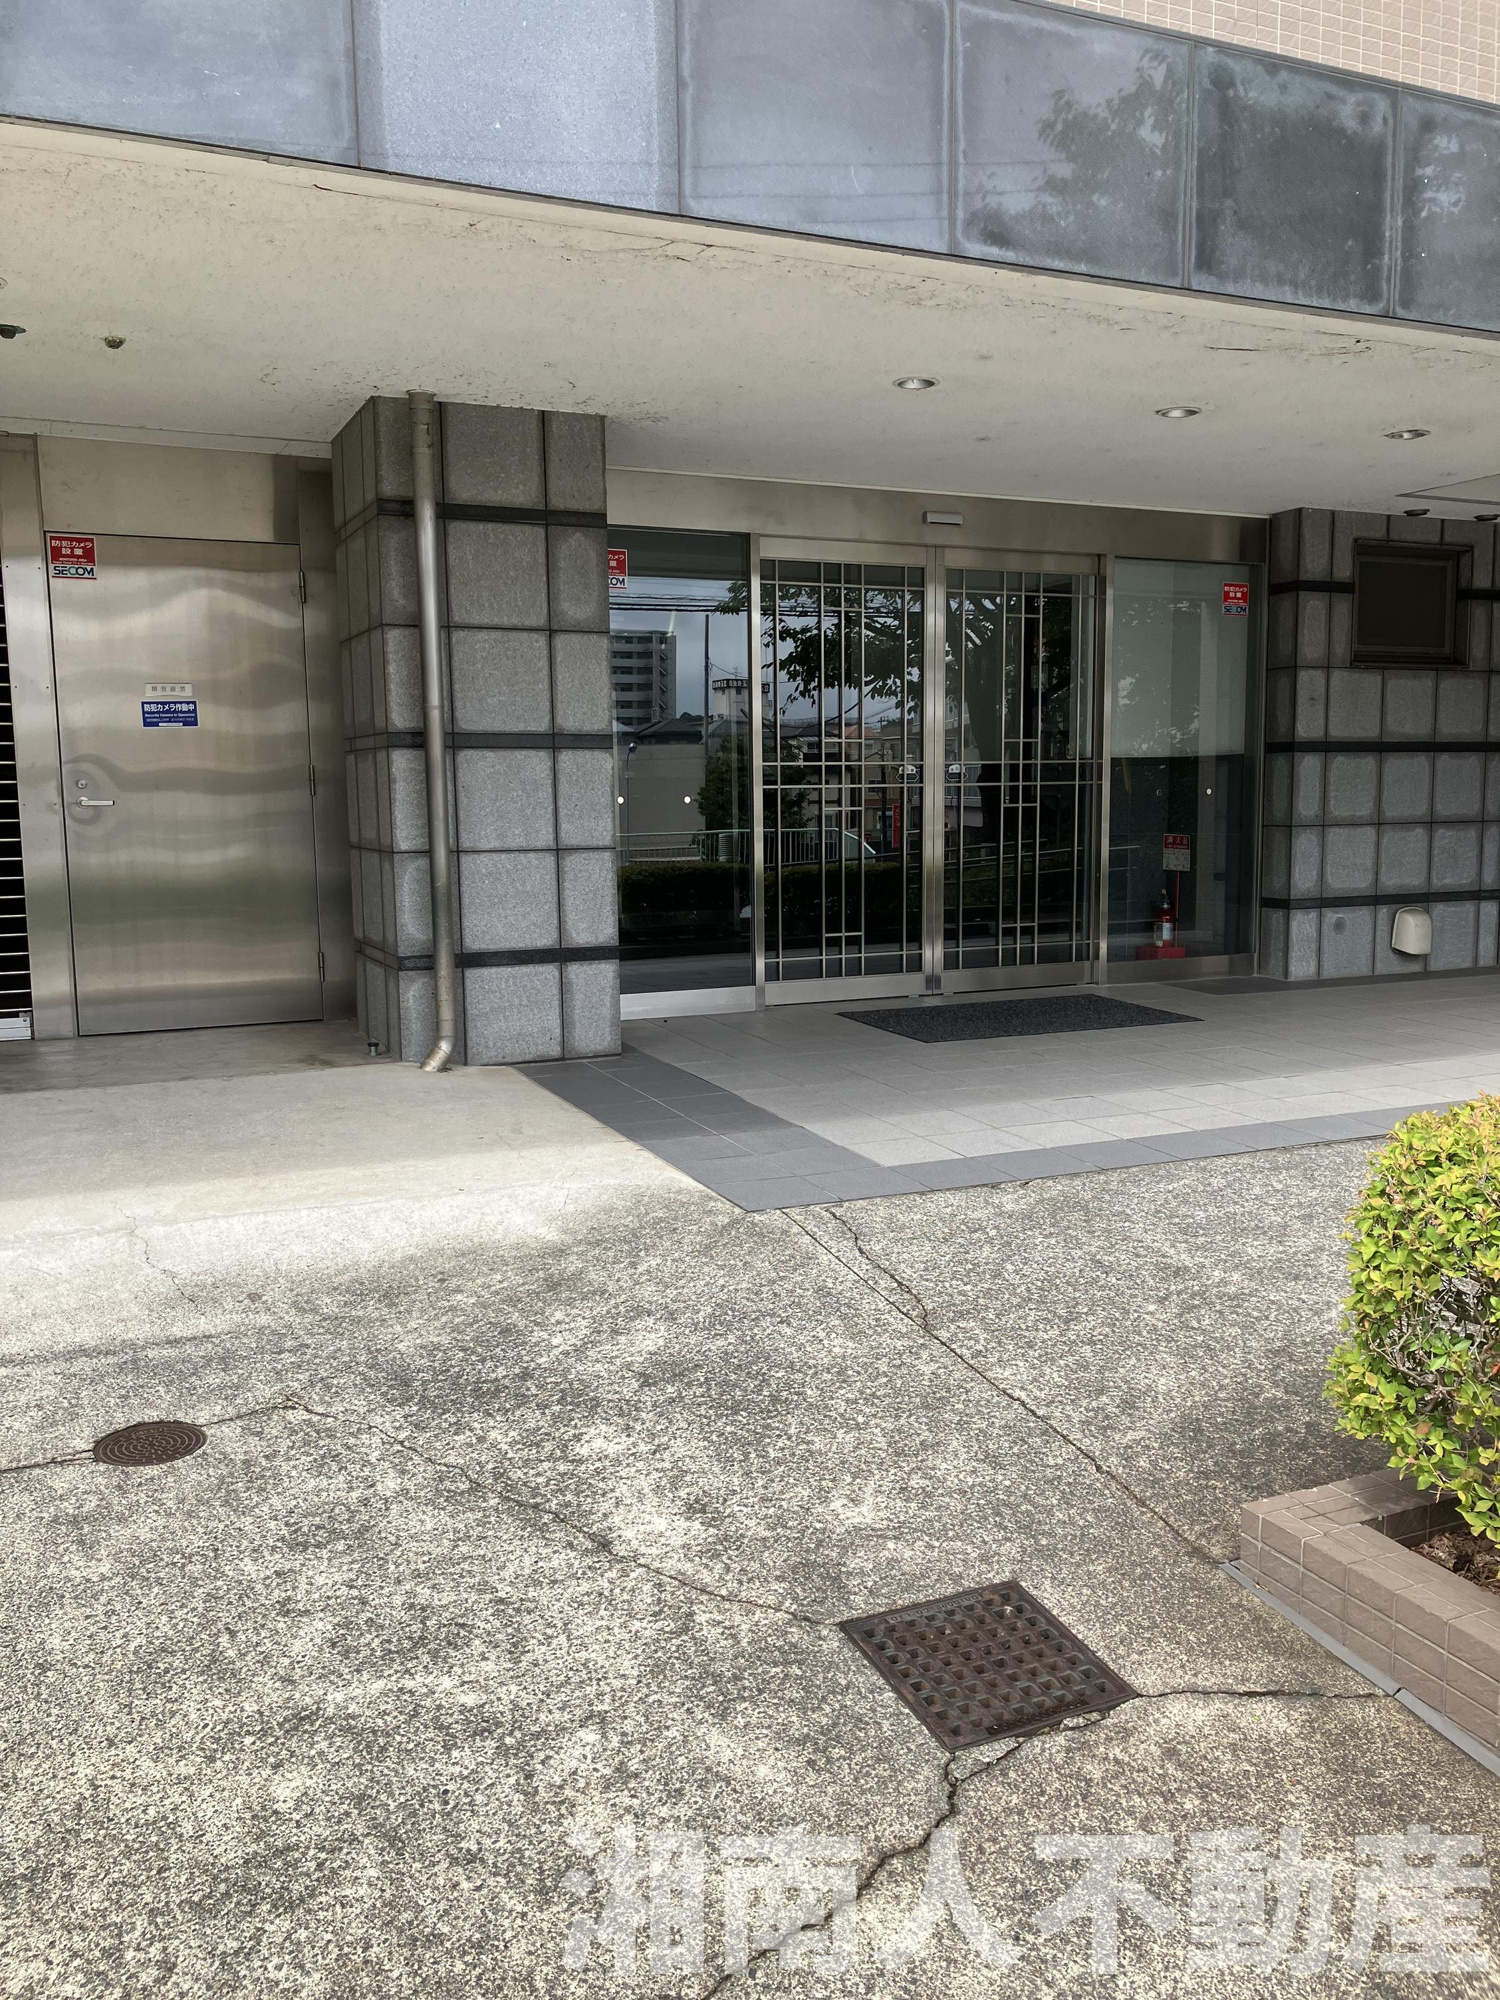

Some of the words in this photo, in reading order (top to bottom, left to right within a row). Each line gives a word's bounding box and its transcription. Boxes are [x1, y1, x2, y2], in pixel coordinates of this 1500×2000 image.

[51, 540, 93, 548] 防犯カメラ
[61, 548, 84, 556] 設置
[53, 565, 95, 577] SECOM
[609, 577, 625, 586] OM
[1224, 606, 1247, 614] SECOM
[143, 703, 195, 712] 防犯カメラ作動中
